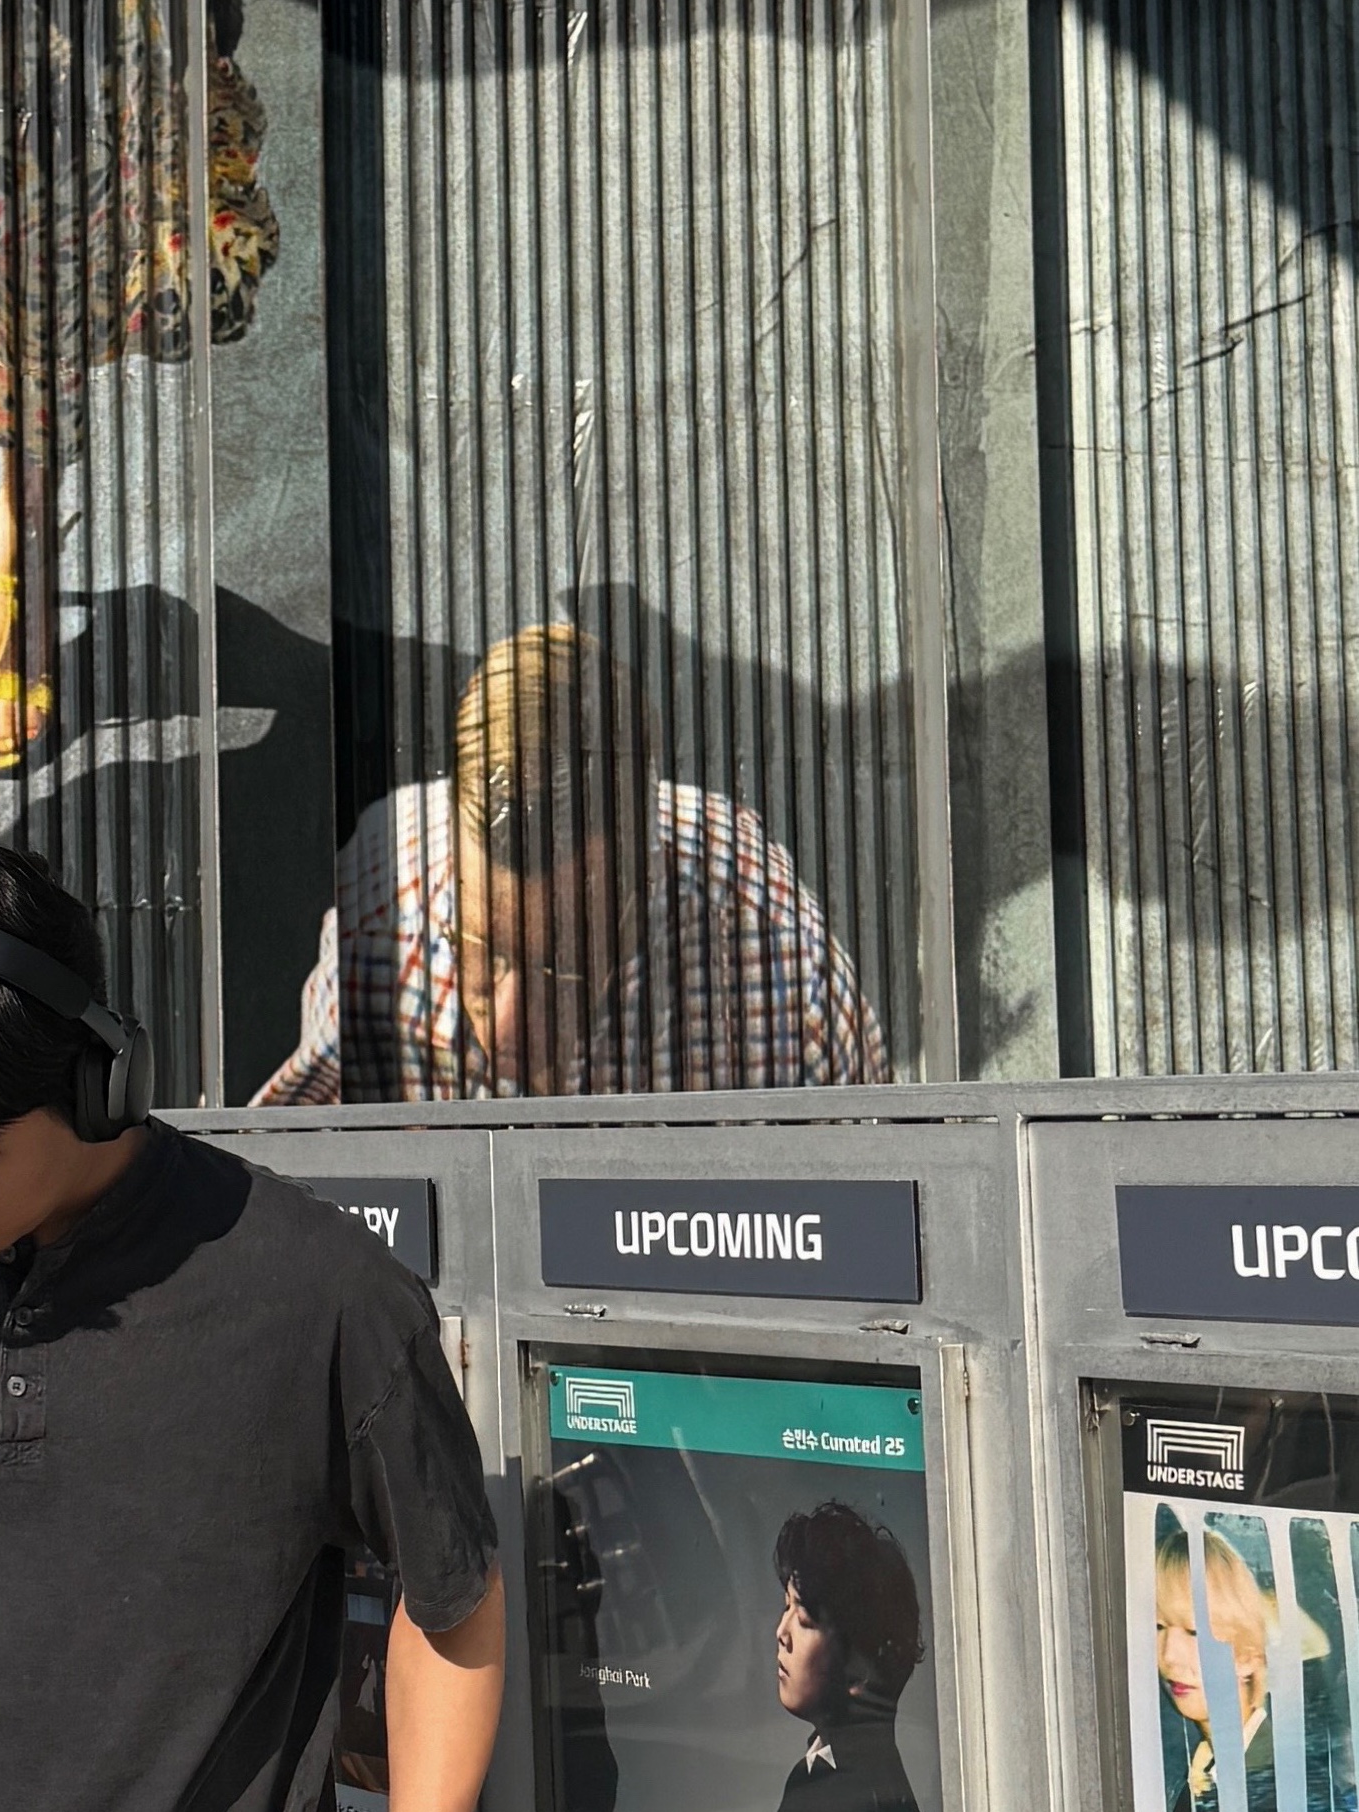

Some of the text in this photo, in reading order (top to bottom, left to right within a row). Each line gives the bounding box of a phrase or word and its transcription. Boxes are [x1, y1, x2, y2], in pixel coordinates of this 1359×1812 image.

[615, 1210, 823, 1261] UPCOMING
[1231, 1224, 1359, 1281] UPC
[567, 1415, 637, 1434] UNDERSTAGE
[821, 1432, 881, 1455] Curated
[885, 1437, 905, 1456] 25
[1147, 1464, 1245, 1491] UNDERSTAGE
[625, 1670, 651, 1689] Park
